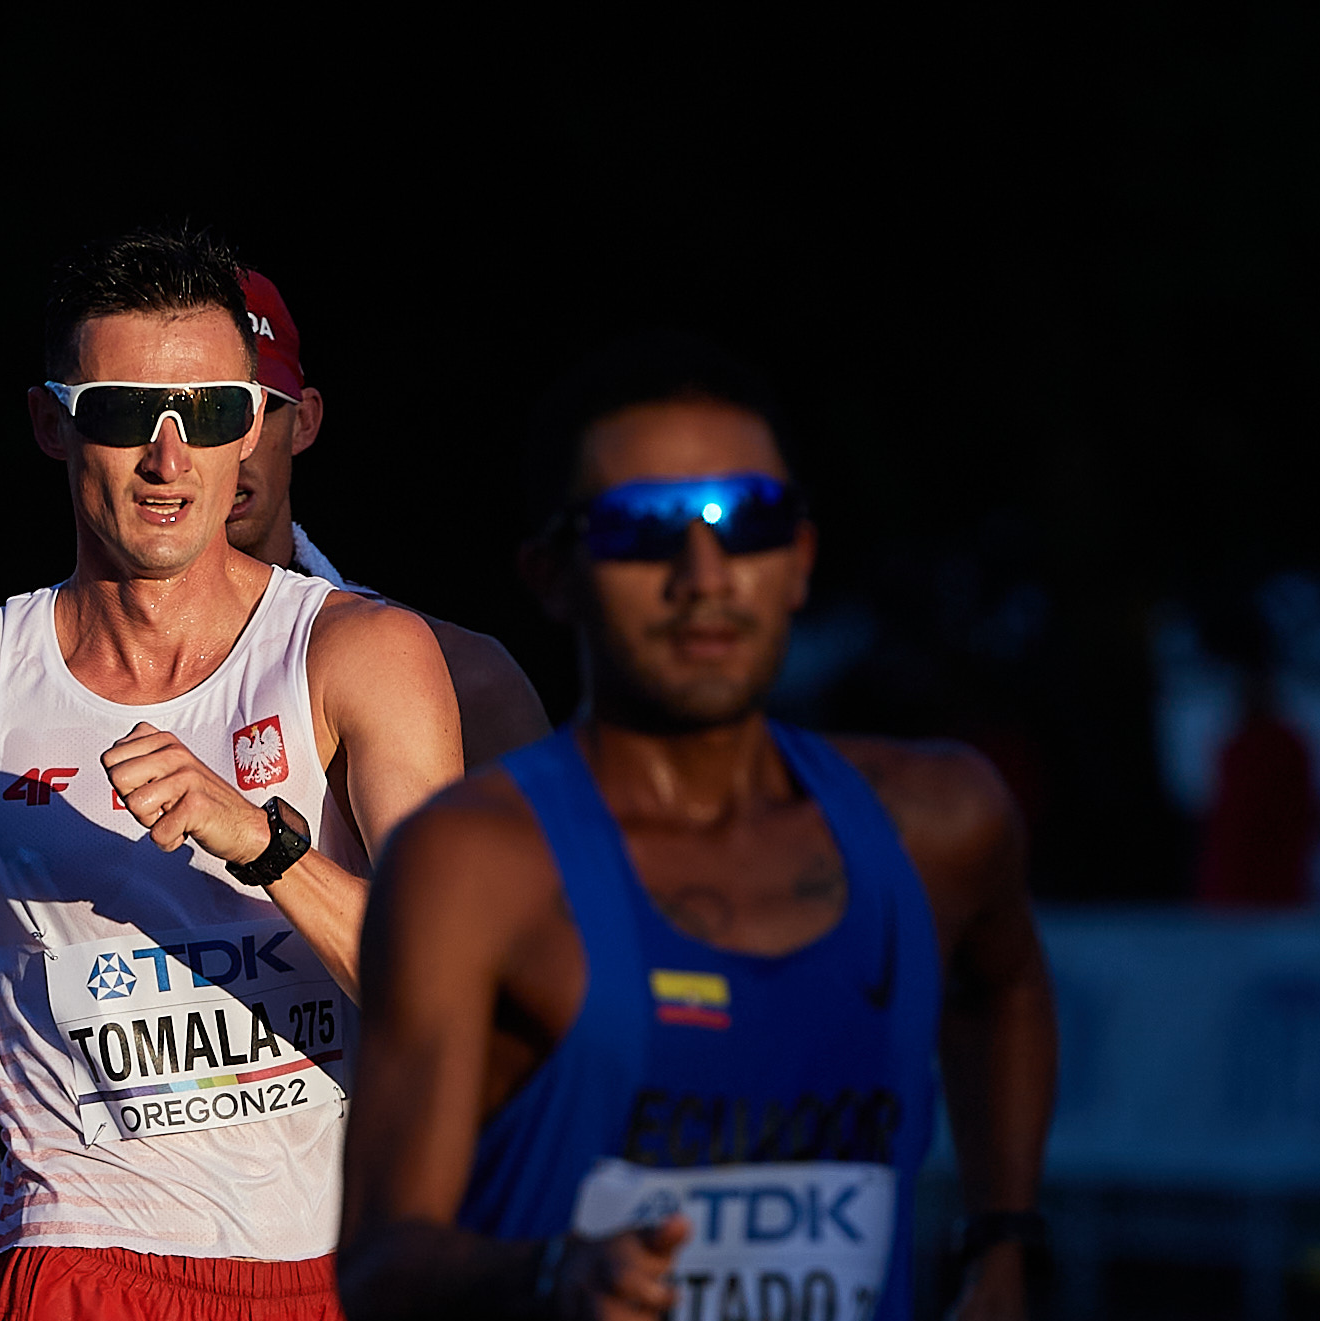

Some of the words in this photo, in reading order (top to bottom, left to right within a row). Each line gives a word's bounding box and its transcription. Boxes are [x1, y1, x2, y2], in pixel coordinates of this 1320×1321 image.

[133, 931, 295, 993] TDK
[69, 1002, 282, 1083] TOMALA
[289, 1000, 335, 1052] 275
[121, 1078, 309, 1132] OREGON22
[688, 1184, 863, 1244] TDK
